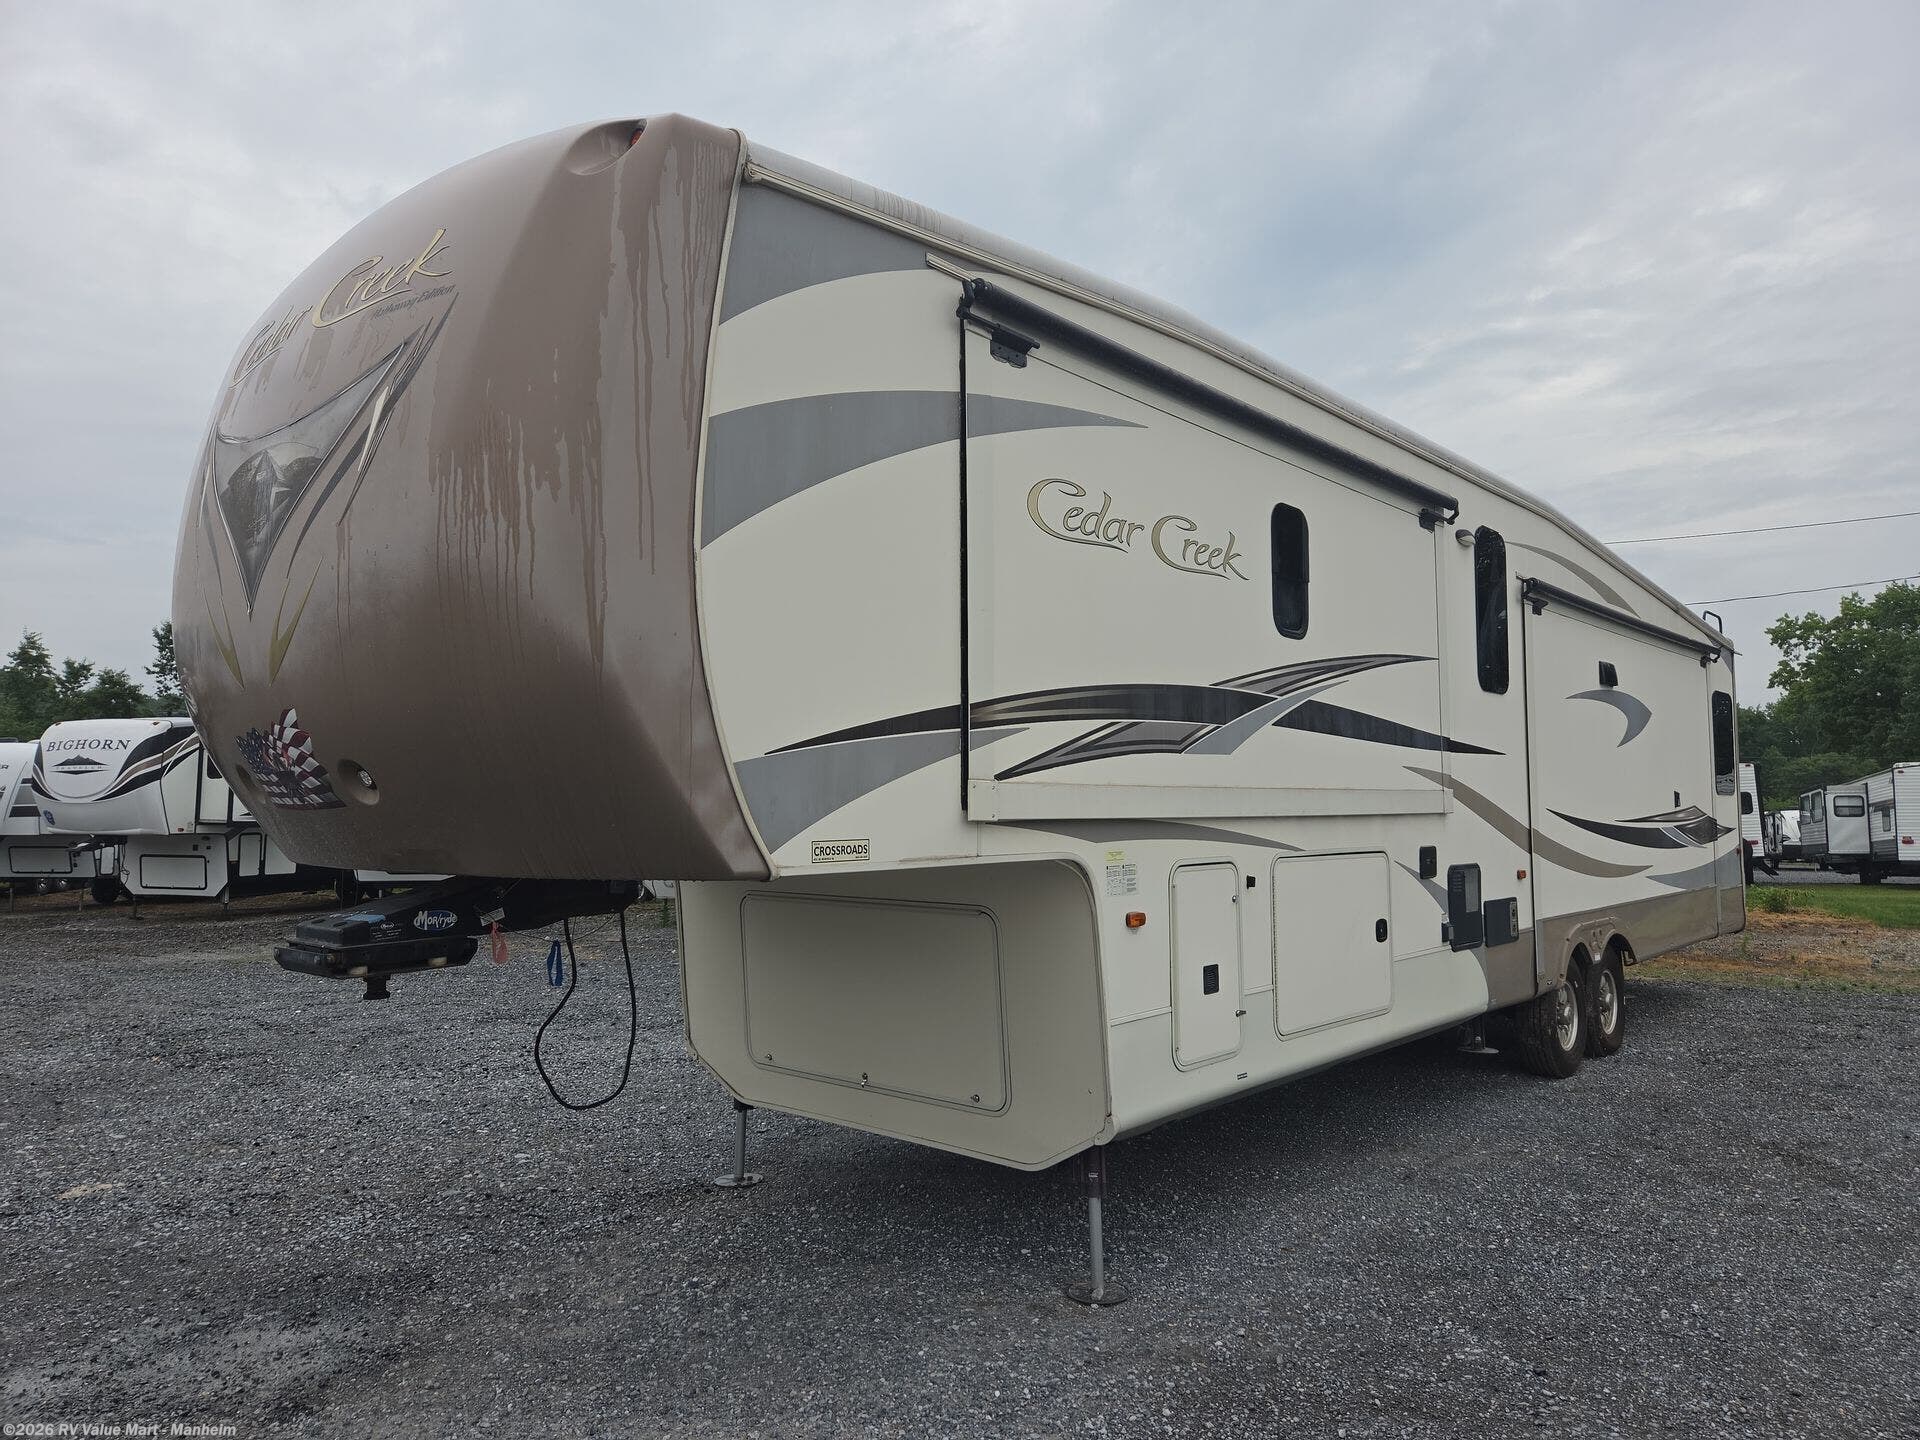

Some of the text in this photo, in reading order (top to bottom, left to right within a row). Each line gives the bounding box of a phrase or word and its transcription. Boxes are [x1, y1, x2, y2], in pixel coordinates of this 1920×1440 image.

[312, 228, 453, 328] Creek
[1026, 477, 1251, 581] Cedar Creek
[46, 738, 131, 752] BIGHORN
[813, 844, 868, 857] CROSSROADS
